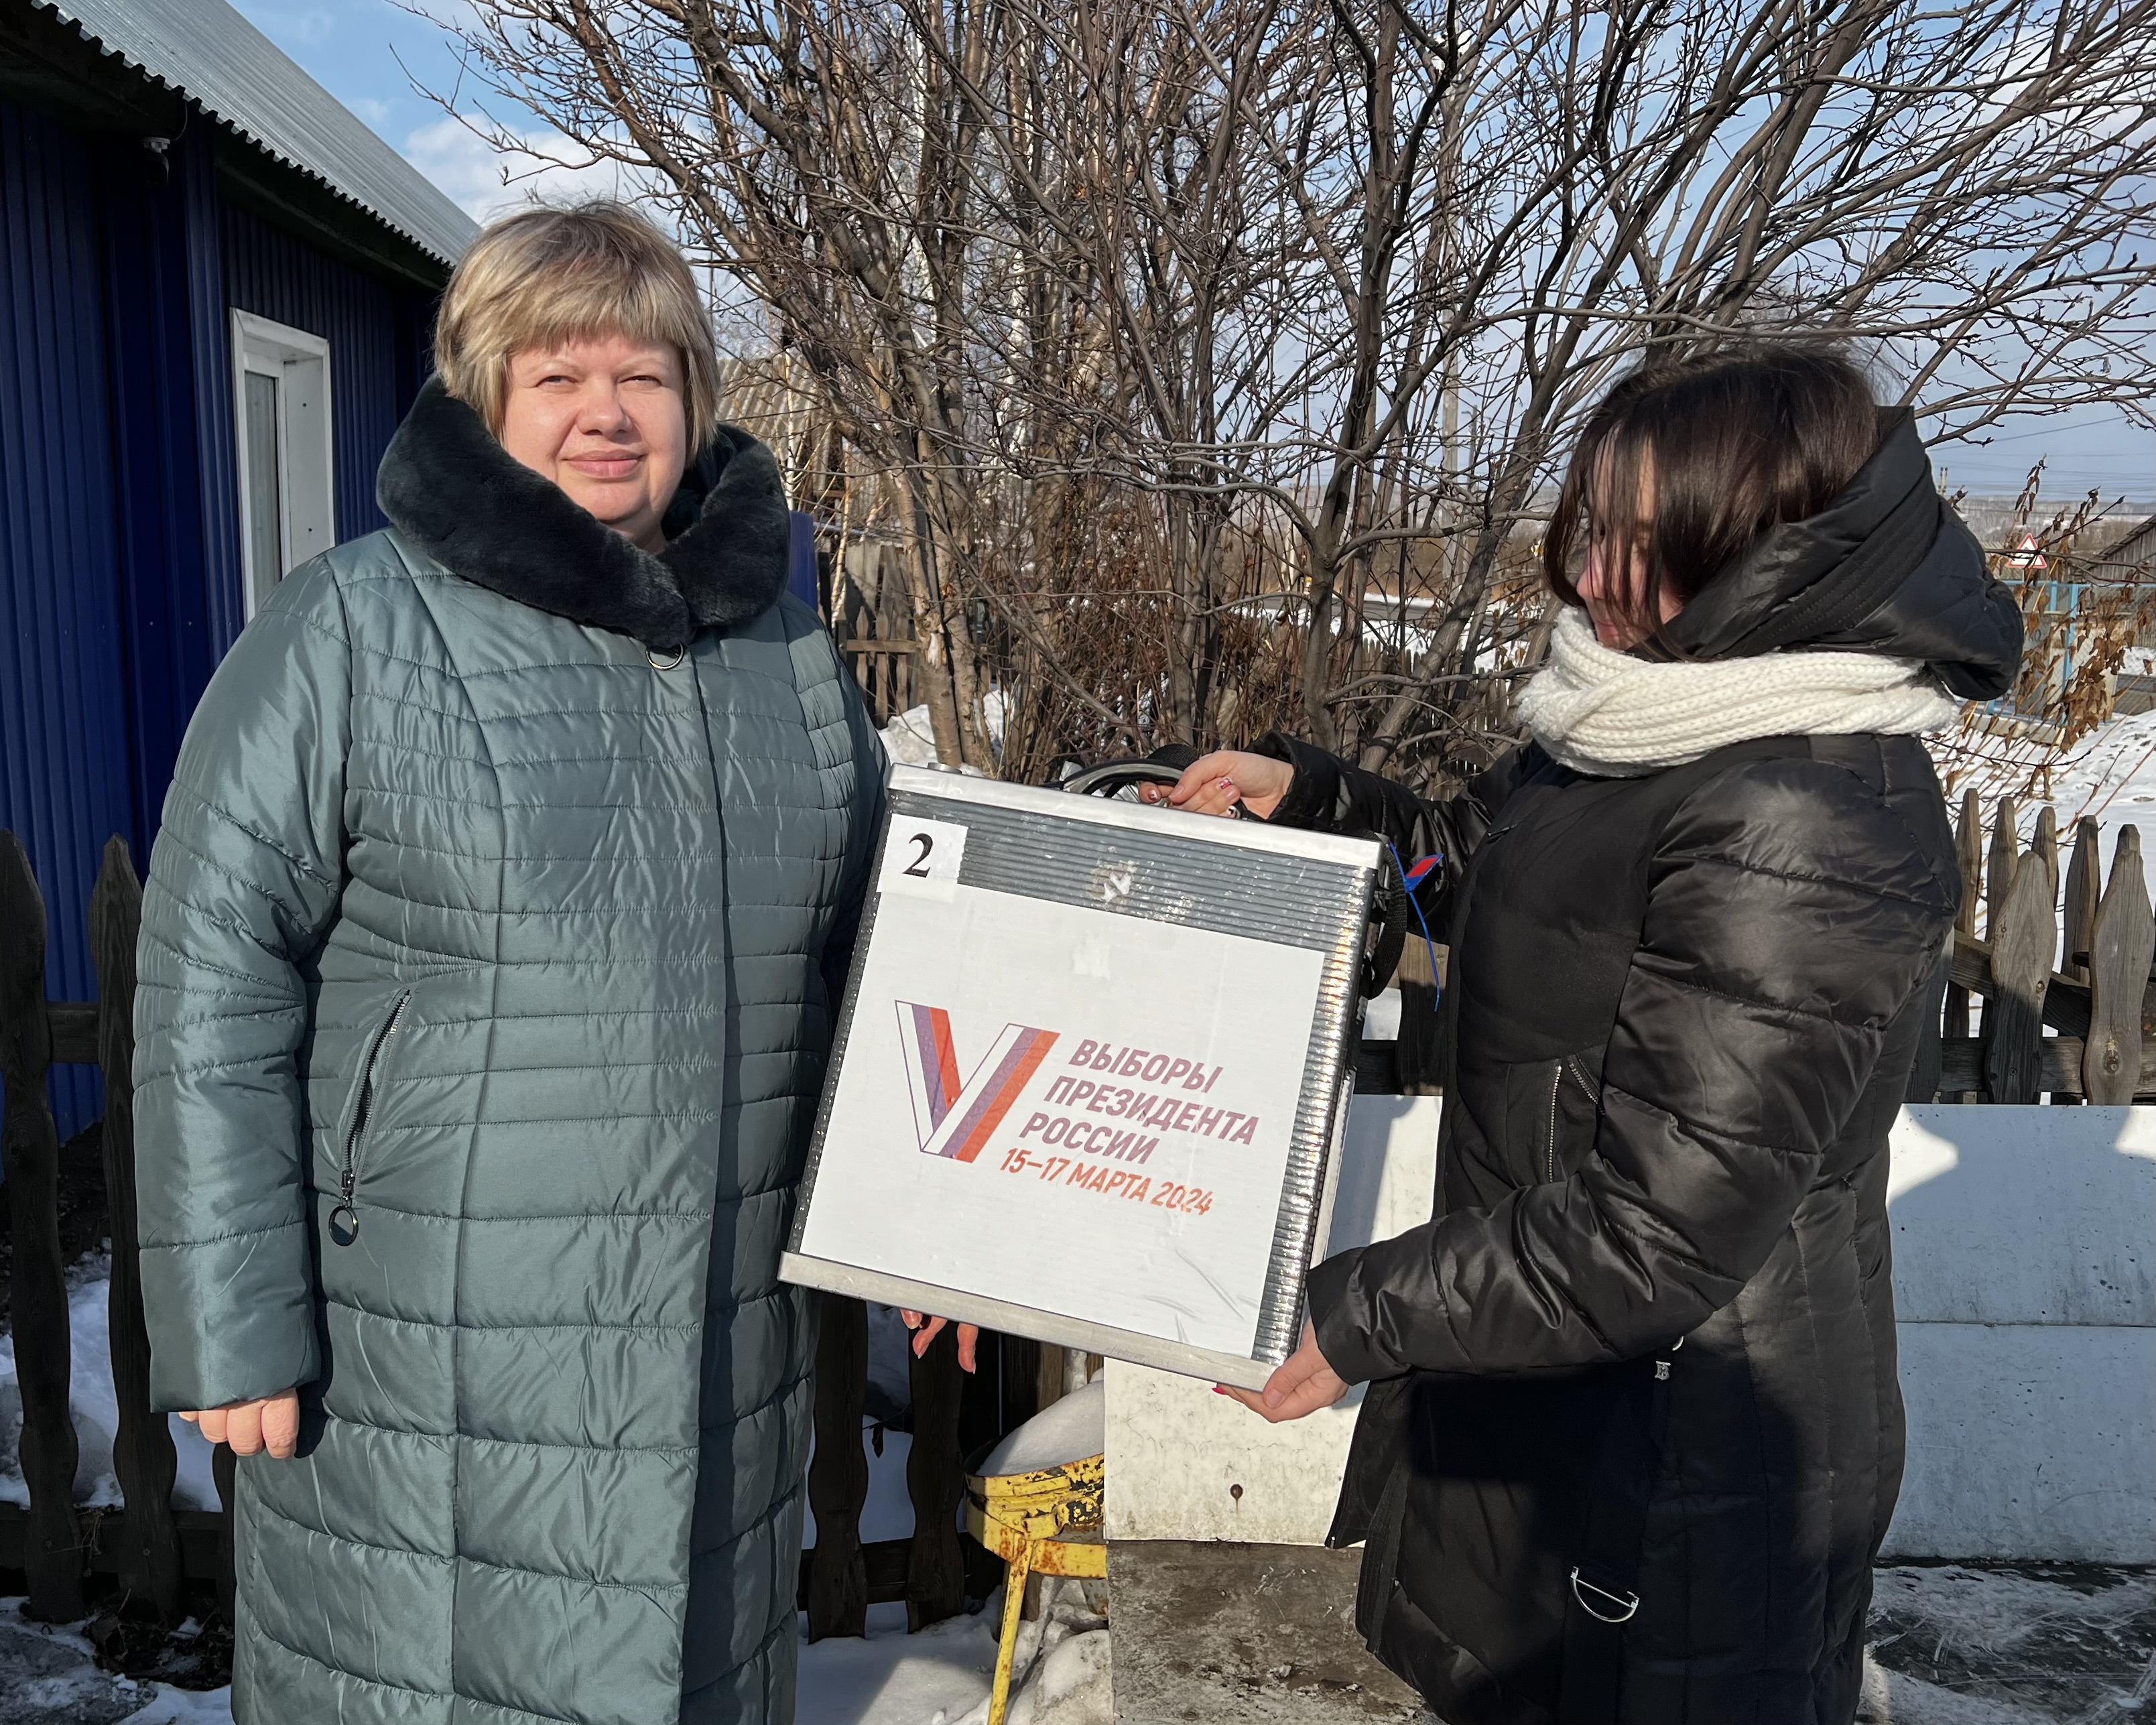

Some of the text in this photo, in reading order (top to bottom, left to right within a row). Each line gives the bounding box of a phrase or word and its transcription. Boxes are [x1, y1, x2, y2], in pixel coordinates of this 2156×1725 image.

[903, 833, 932, 879] 2
[1068, 1039, 1224, 1093] ВЫБОРЫ
[1043, 1076, 1259, 1145] ПРЕЗИДЕНТА
[1019, 1112, 1161, 1165] РОССИИ
[1066, 1162, 1151, 1202] МАРТА
[1150, 1181, 1213, 1216] 2024
